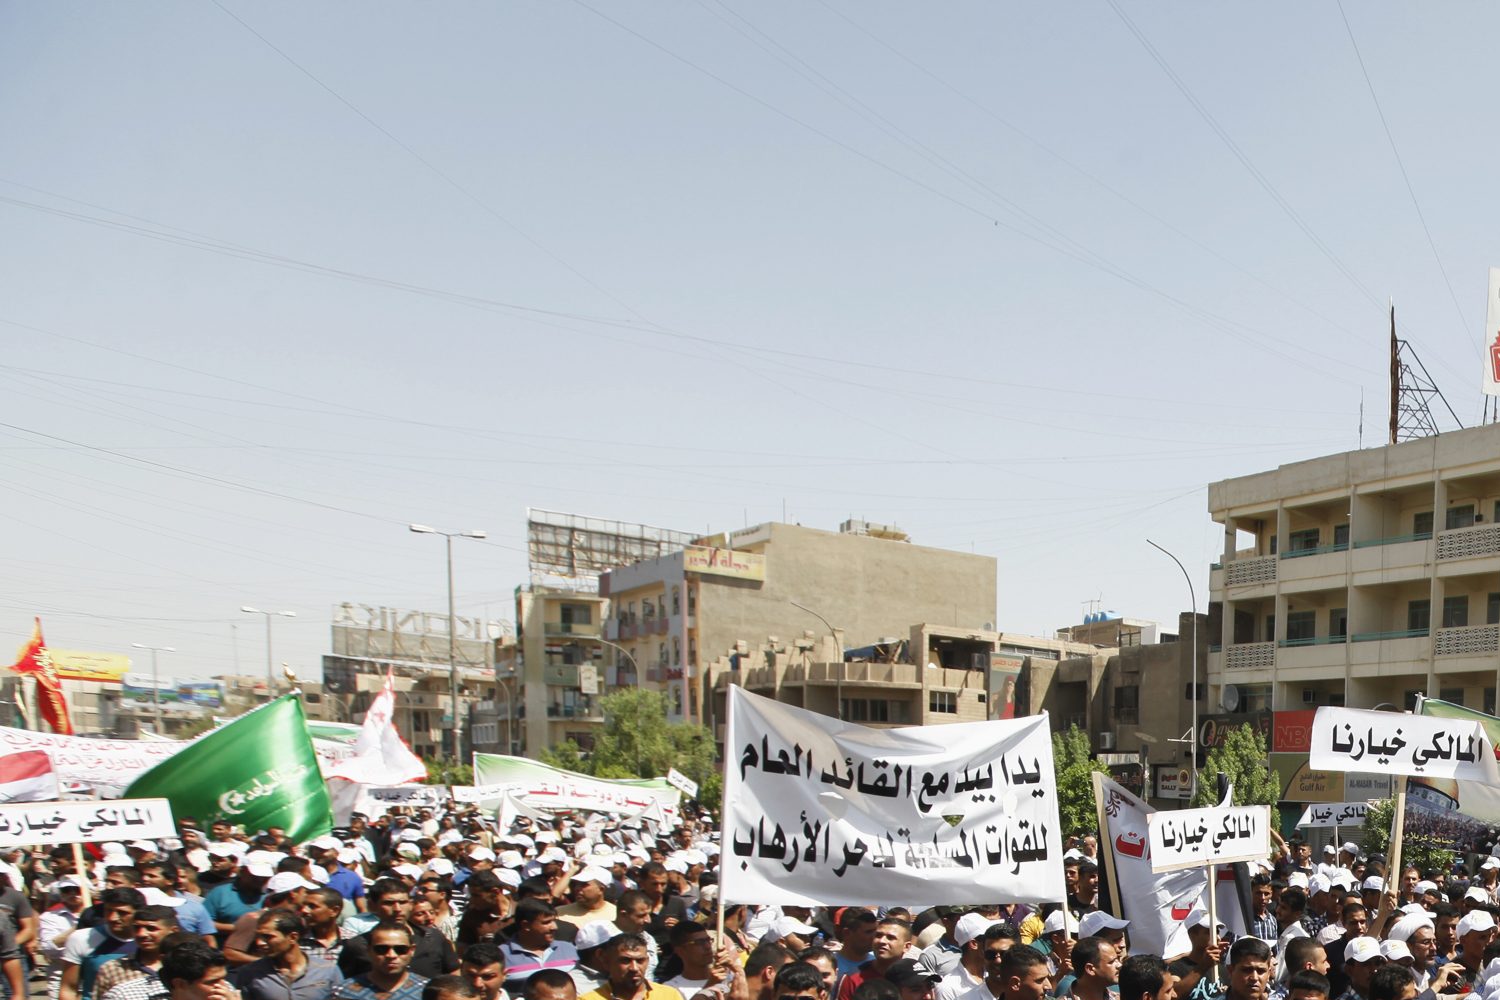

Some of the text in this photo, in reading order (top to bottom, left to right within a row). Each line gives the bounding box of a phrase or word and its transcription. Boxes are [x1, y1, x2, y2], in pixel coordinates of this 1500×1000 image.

[1332, 723, 1483, 772] المالكي خيارنا
[740, 733, 1044, 813] يدا بيد مع القائد العام
[0, 807, 153, 837] المالكي خيارن
[1161, 817, 1208, 853] خيارنا
[1211, 814, 1256, 855] المالكي
[1310, 805, 1367, 825] لمالكي خيار
[733, 809, 830, 875] الأرهاب
[985, 817, 1049, 876] للقوات
